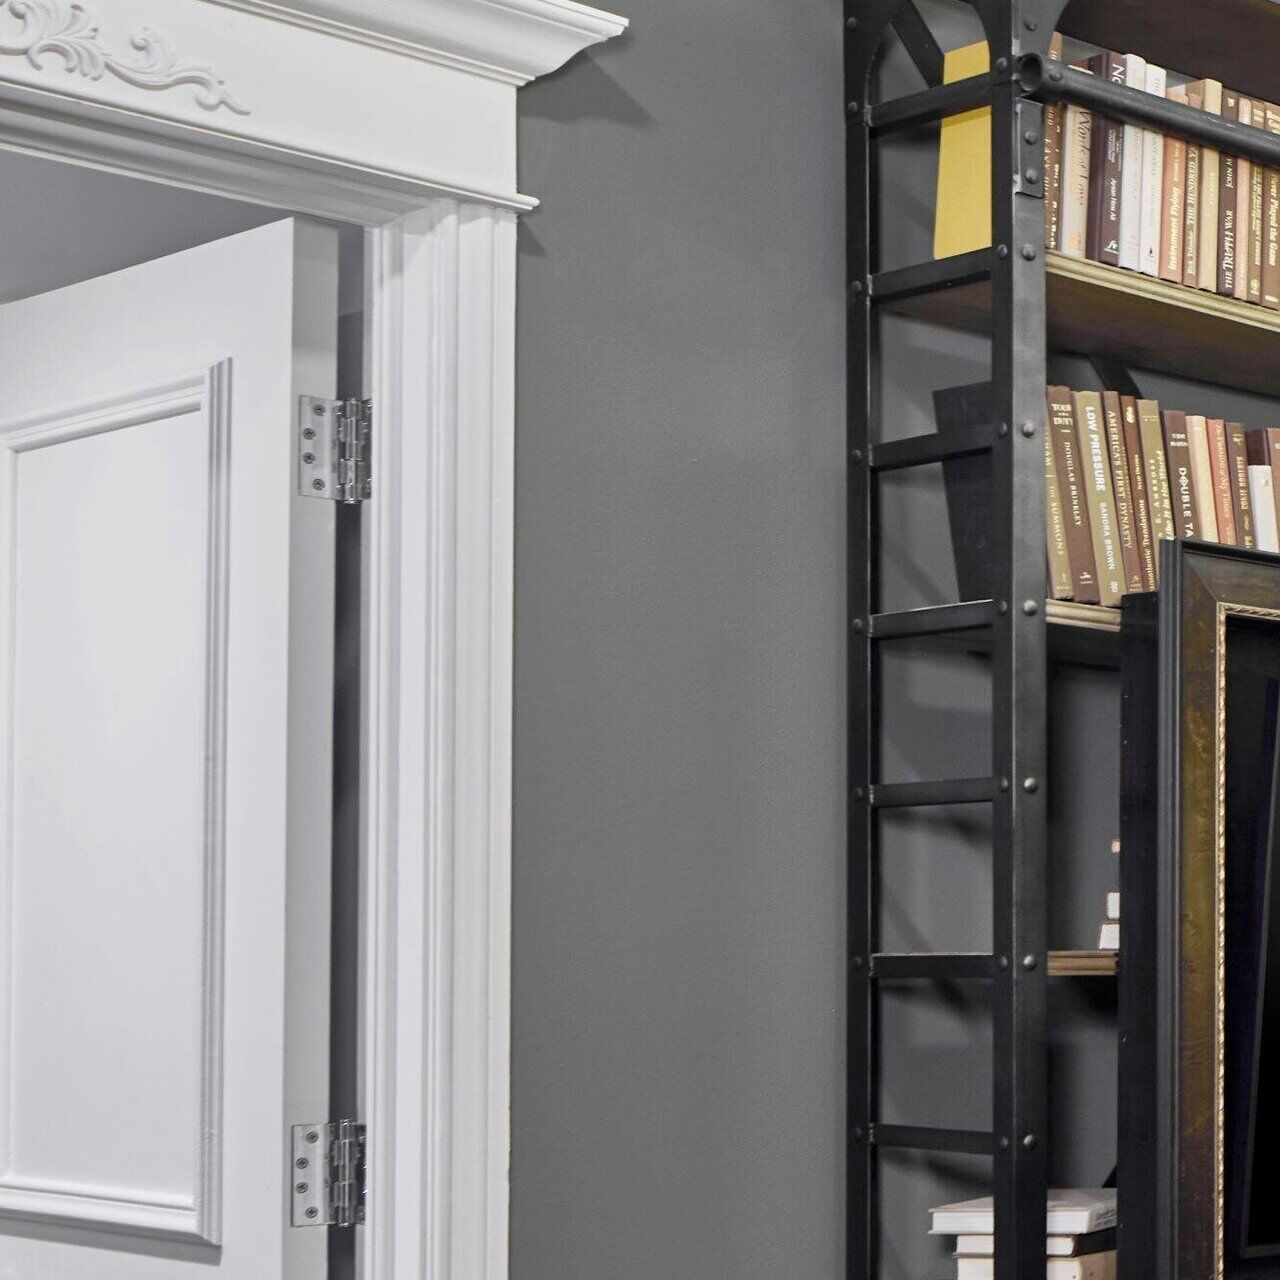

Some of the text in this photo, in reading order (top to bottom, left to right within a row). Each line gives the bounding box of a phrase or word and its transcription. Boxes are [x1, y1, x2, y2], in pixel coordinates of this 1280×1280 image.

[1170, 186, 1181, 215] Flying
[1187, 161, 1198, 204] HUNDRED
[1225, 168, 1234, 188] JOHN
[1187, 206, 1196, 225] THE
[1168, 217, 1179, 270] Instrument
[1222, 210, 1234, 288] THE TRUTH WAR
[1085, 406, 1106, 492] LOW PRESSURE
[1108, 410, 1121, 467] AMERICA'S
[1064, 442, 1082, 527] DOUGLAS BRINKLEY
[1115, 470, 1126, 499] FIRST
[1178, 467, 1194, 538] DOUBLE TA
[1051, 503, 1064, 556] SUMMONS
[1099, 502, 1115, 571] SANDRA BROWN
[1119, 503, 1132, 549] DYNASTY
[1139, 500, 1150, 547] Translations
